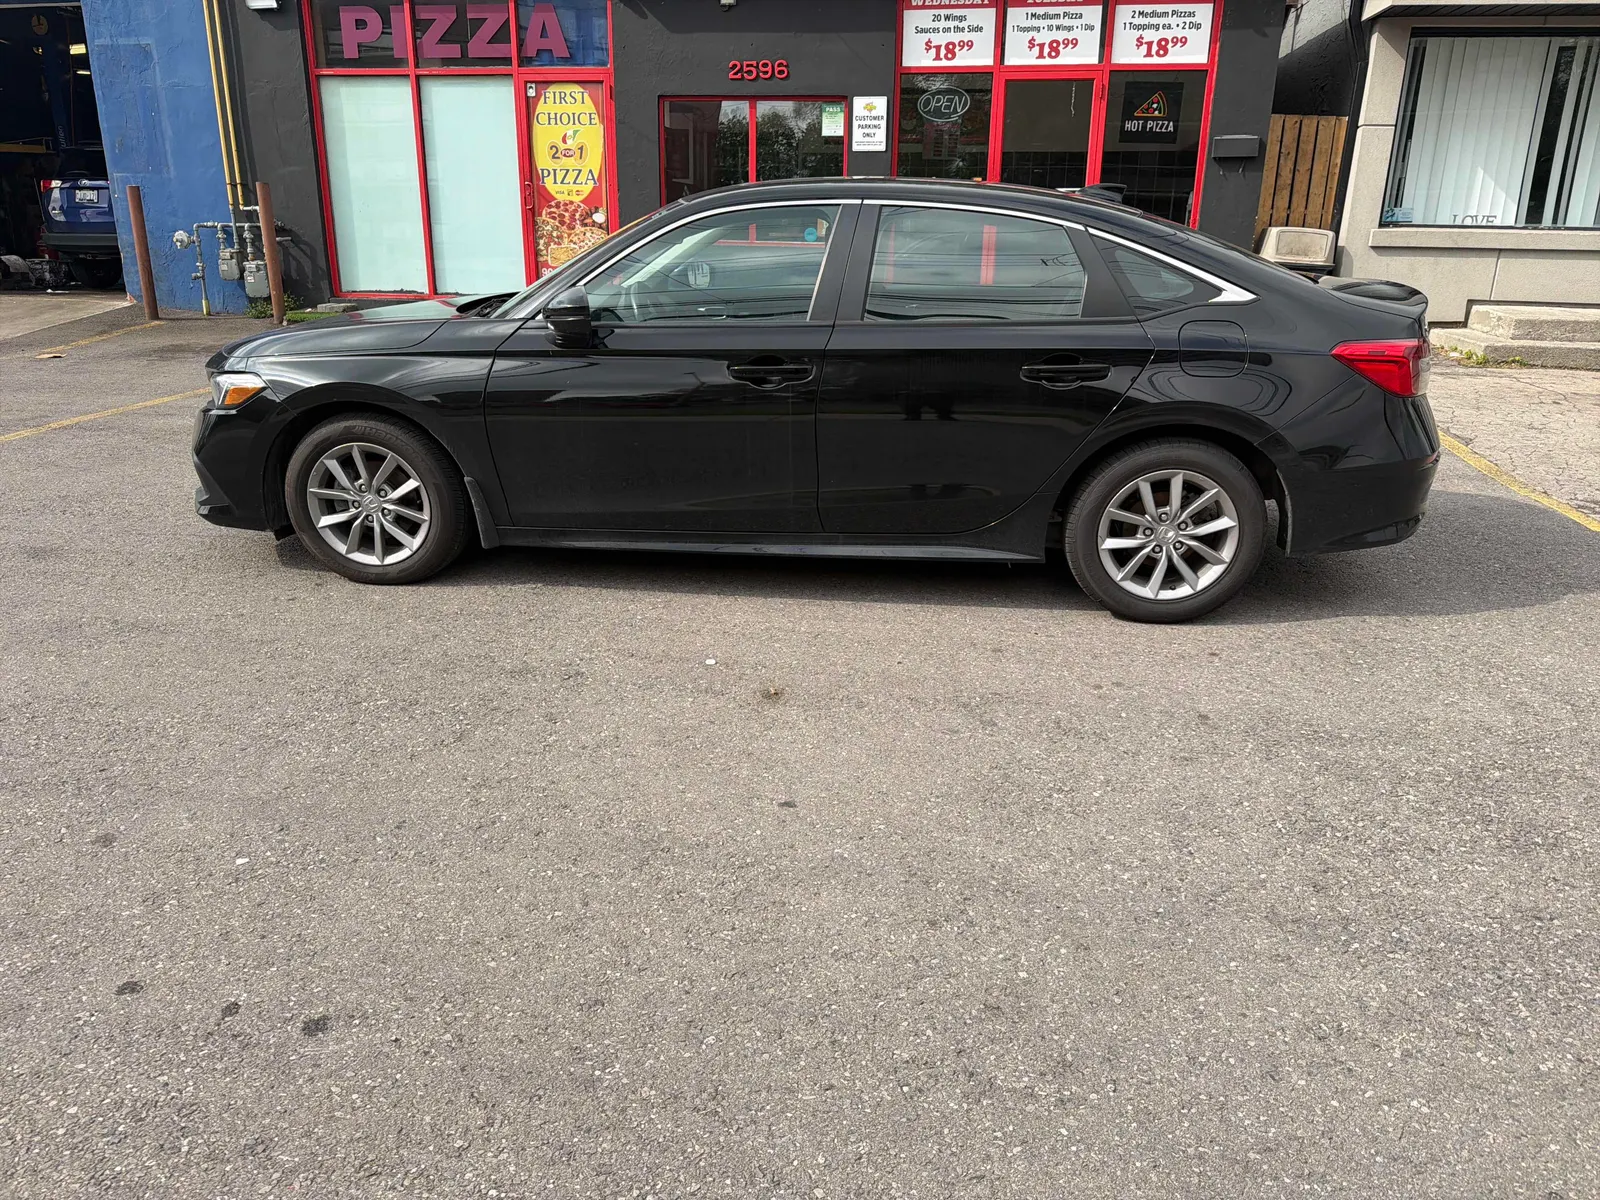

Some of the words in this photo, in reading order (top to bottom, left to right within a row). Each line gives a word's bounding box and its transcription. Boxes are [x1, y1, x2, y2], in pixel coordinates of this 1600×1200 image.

[932, 14, 942, 22] 20
[944, 13, 967, 23] Wings
[1025, 12, 1029, 20] 1
[1030, 12, 1061, 20] Medium
[1062, 11, 1083, 20] Pizza
[1131, 10, 1136, 18] 2
[1138, 10, 1169, 18] Medium
[1171, 9, 1196, 18] Pizzas
[339, 2, 571, 58] PIZZA
[914, 26, 940, 34] Sauces
[953, 25, 965, 33] the
[967, 24, 984, 33] Side
[1016, 25, 1040, 33] Topping
[1055, 24, 1074, 32] Wings
[1084, 23, 1095, 32] Dip
[1123, 22, 1126, 30] 1
[1128, 22, 1160, 31] Topping
[1182, 21, 1186, 29] 2
[1188, 21, 1202, 31] Dip
[728, 60, 788, 80] 2596
[542, 90, 588, 105] FIRST
[920, 95, 966, 112] OPEN
[536, 112, 597, 125] CHOICE
[1124, 120, 1144, 131] HOT
[1146, 120, 1174, 132] PIZZA
[550, 145, 560, 159] 2
[578, 145, 584, 160] 1
[540, 168, 598, 185] PIZZA
